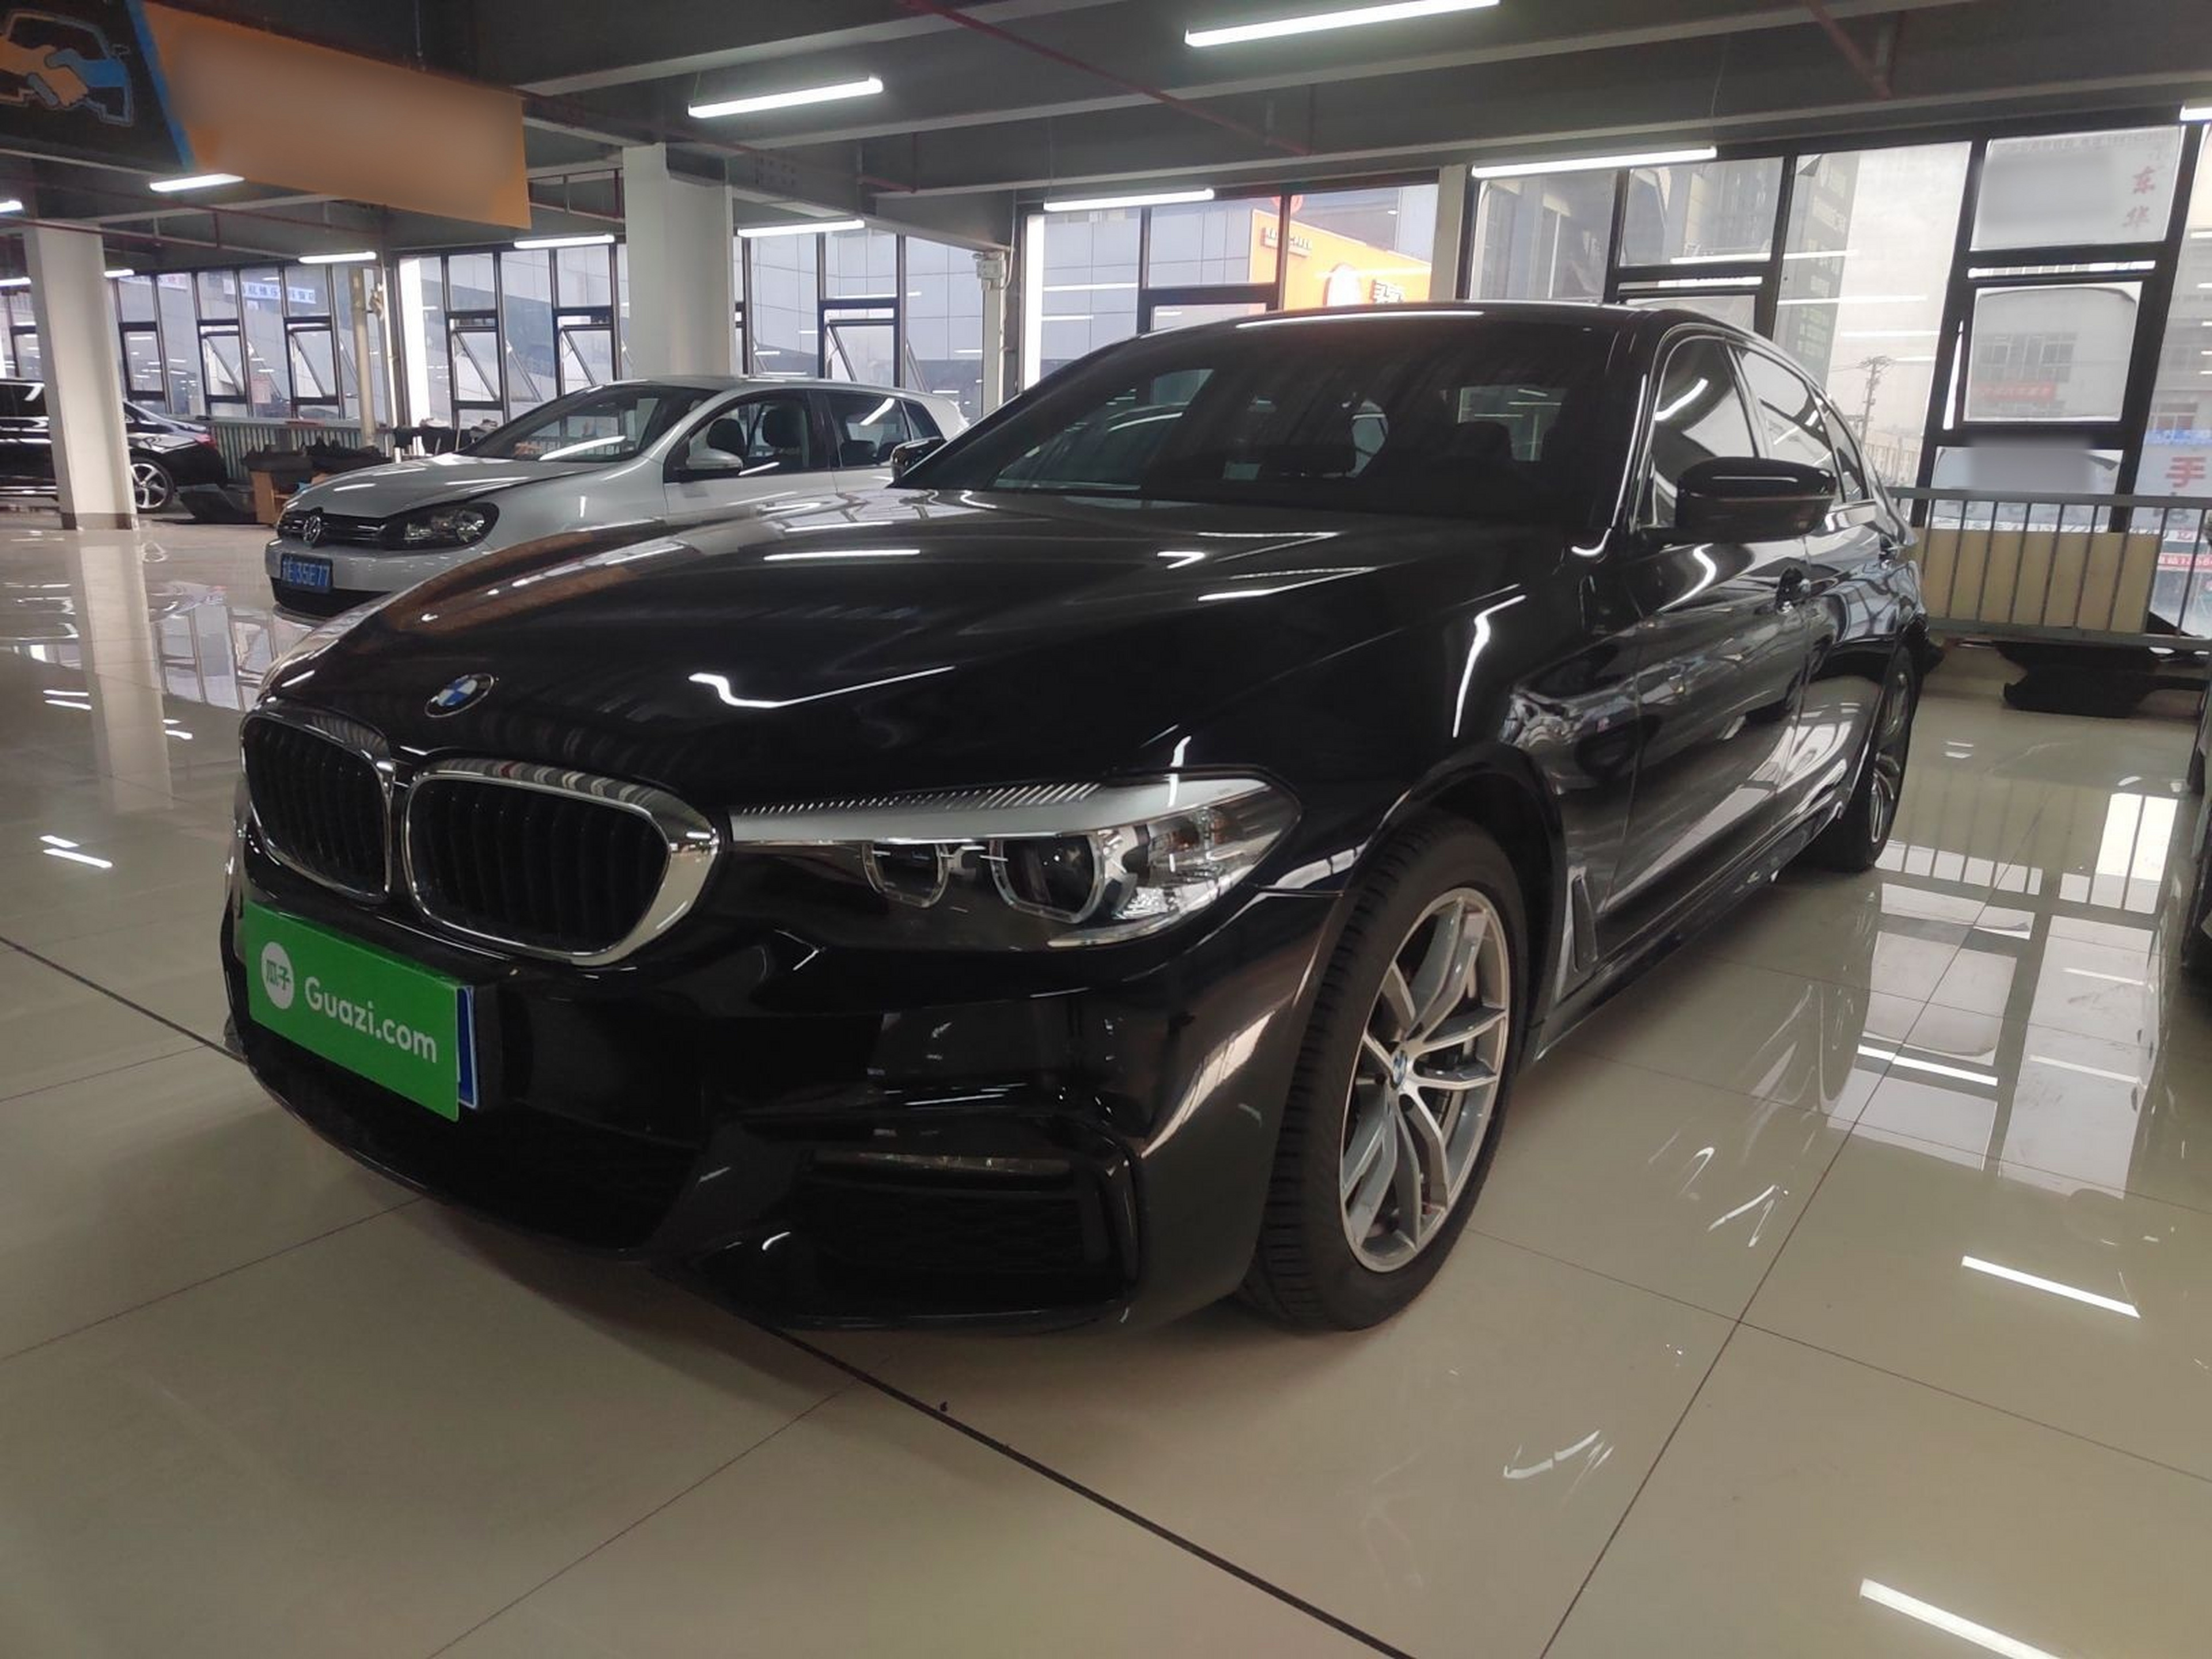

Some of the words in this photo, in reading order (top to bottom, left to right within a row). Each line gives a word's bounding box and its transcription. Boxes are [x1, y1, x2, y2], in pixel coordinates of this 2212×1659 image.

[2166, 456, 2207, 488] 手
[265, 959, 291, 991] 瓜子
[304, 975, 438, 1063] Guazi.com
